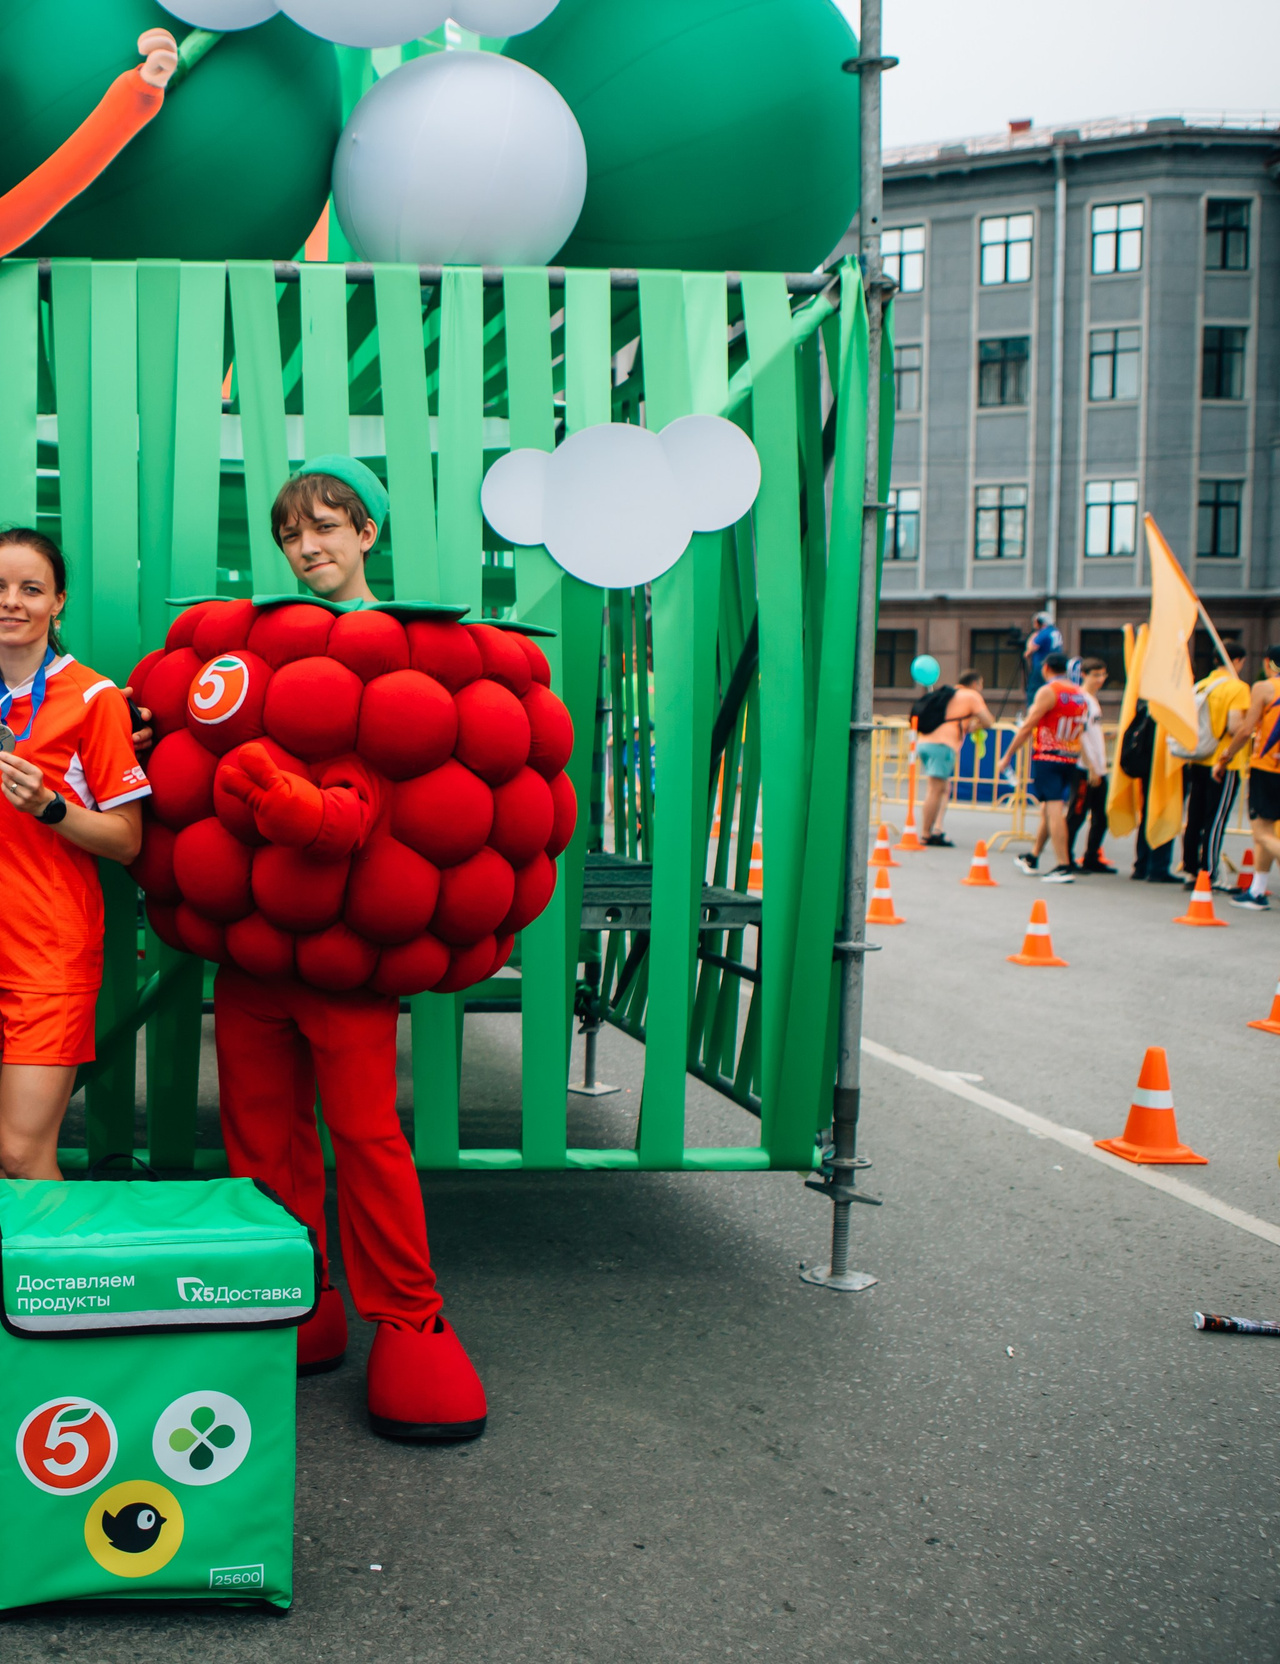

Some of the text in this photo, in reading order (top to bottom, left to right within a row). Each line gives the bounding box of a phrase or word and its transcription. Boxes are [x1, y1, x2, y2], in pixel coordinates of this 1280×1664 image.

[194, 657, 242, 710] 5
[16, 1274, 136, 1292] Доставляем
[17, 1293, 111, 1312] продукты
[42, 1403, 96, 1476] 5
[214, 1571, 261, 1586] 25600
